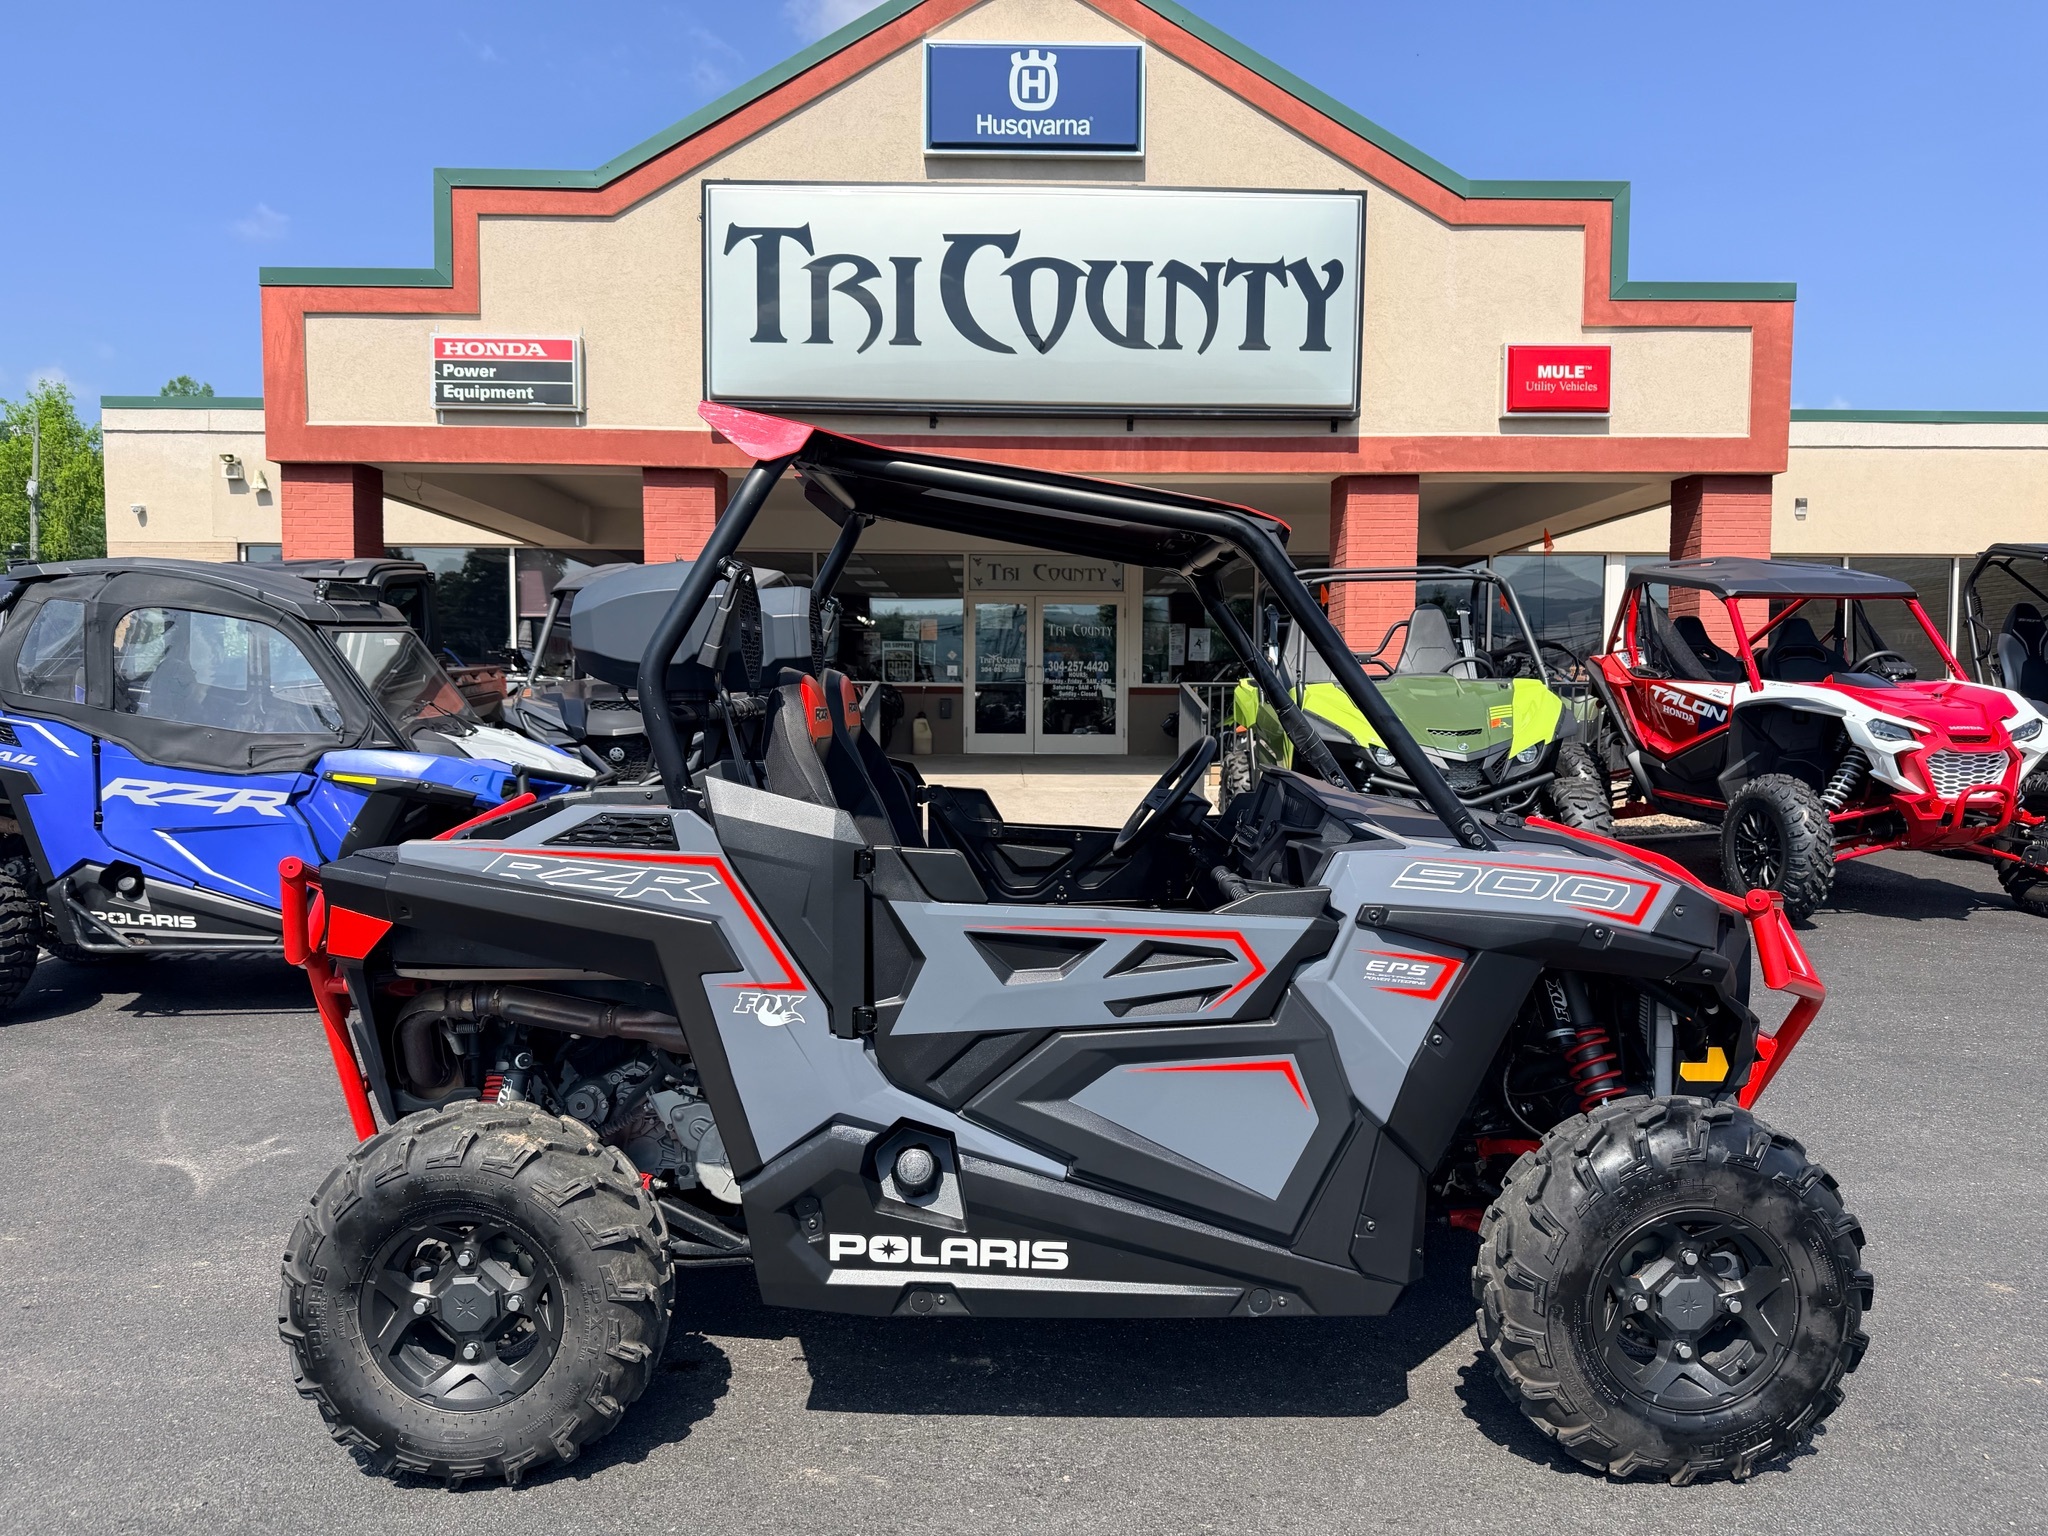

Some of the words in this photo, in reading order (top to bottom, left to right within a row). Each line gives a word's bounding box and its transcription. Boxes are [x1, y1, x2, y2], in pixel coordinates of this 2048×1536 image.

[976, 113, 1091, 139] Husqvarna
[442, 341, 547, 357] HONDA
[442, 363, 497, 378] Power
[443, 384, 534, 401] Equipment
[1525, 381, 1557, 394] Utility
[1559, 381, 1598, 392] Vehicles
[1048, 660, 1109, 672] 304-257-4420
[1052, 684, 1075, 692] Saturday
[1650, 684, 1728, 723] TALON
[815, 707, 829, 720] RZR
[1662, 704, 1696, 724] HONDA
[0, 751, 39, 767] AIL
[101, 777, 291, 818] RZR
[481, 852, 722, 905] RZR
[1390, 860, 1632, 911] 900
[91, 910, 198, 929] POLARIS
[1365, 960, 1430, 976] EPS
[1363, 975, 1391, 983] POWER
[1391, 977, 1427, 986] STEERING
[733, 991, 808, 1027] FOX
[828, 1233, 1069, 1270] POLARIS
